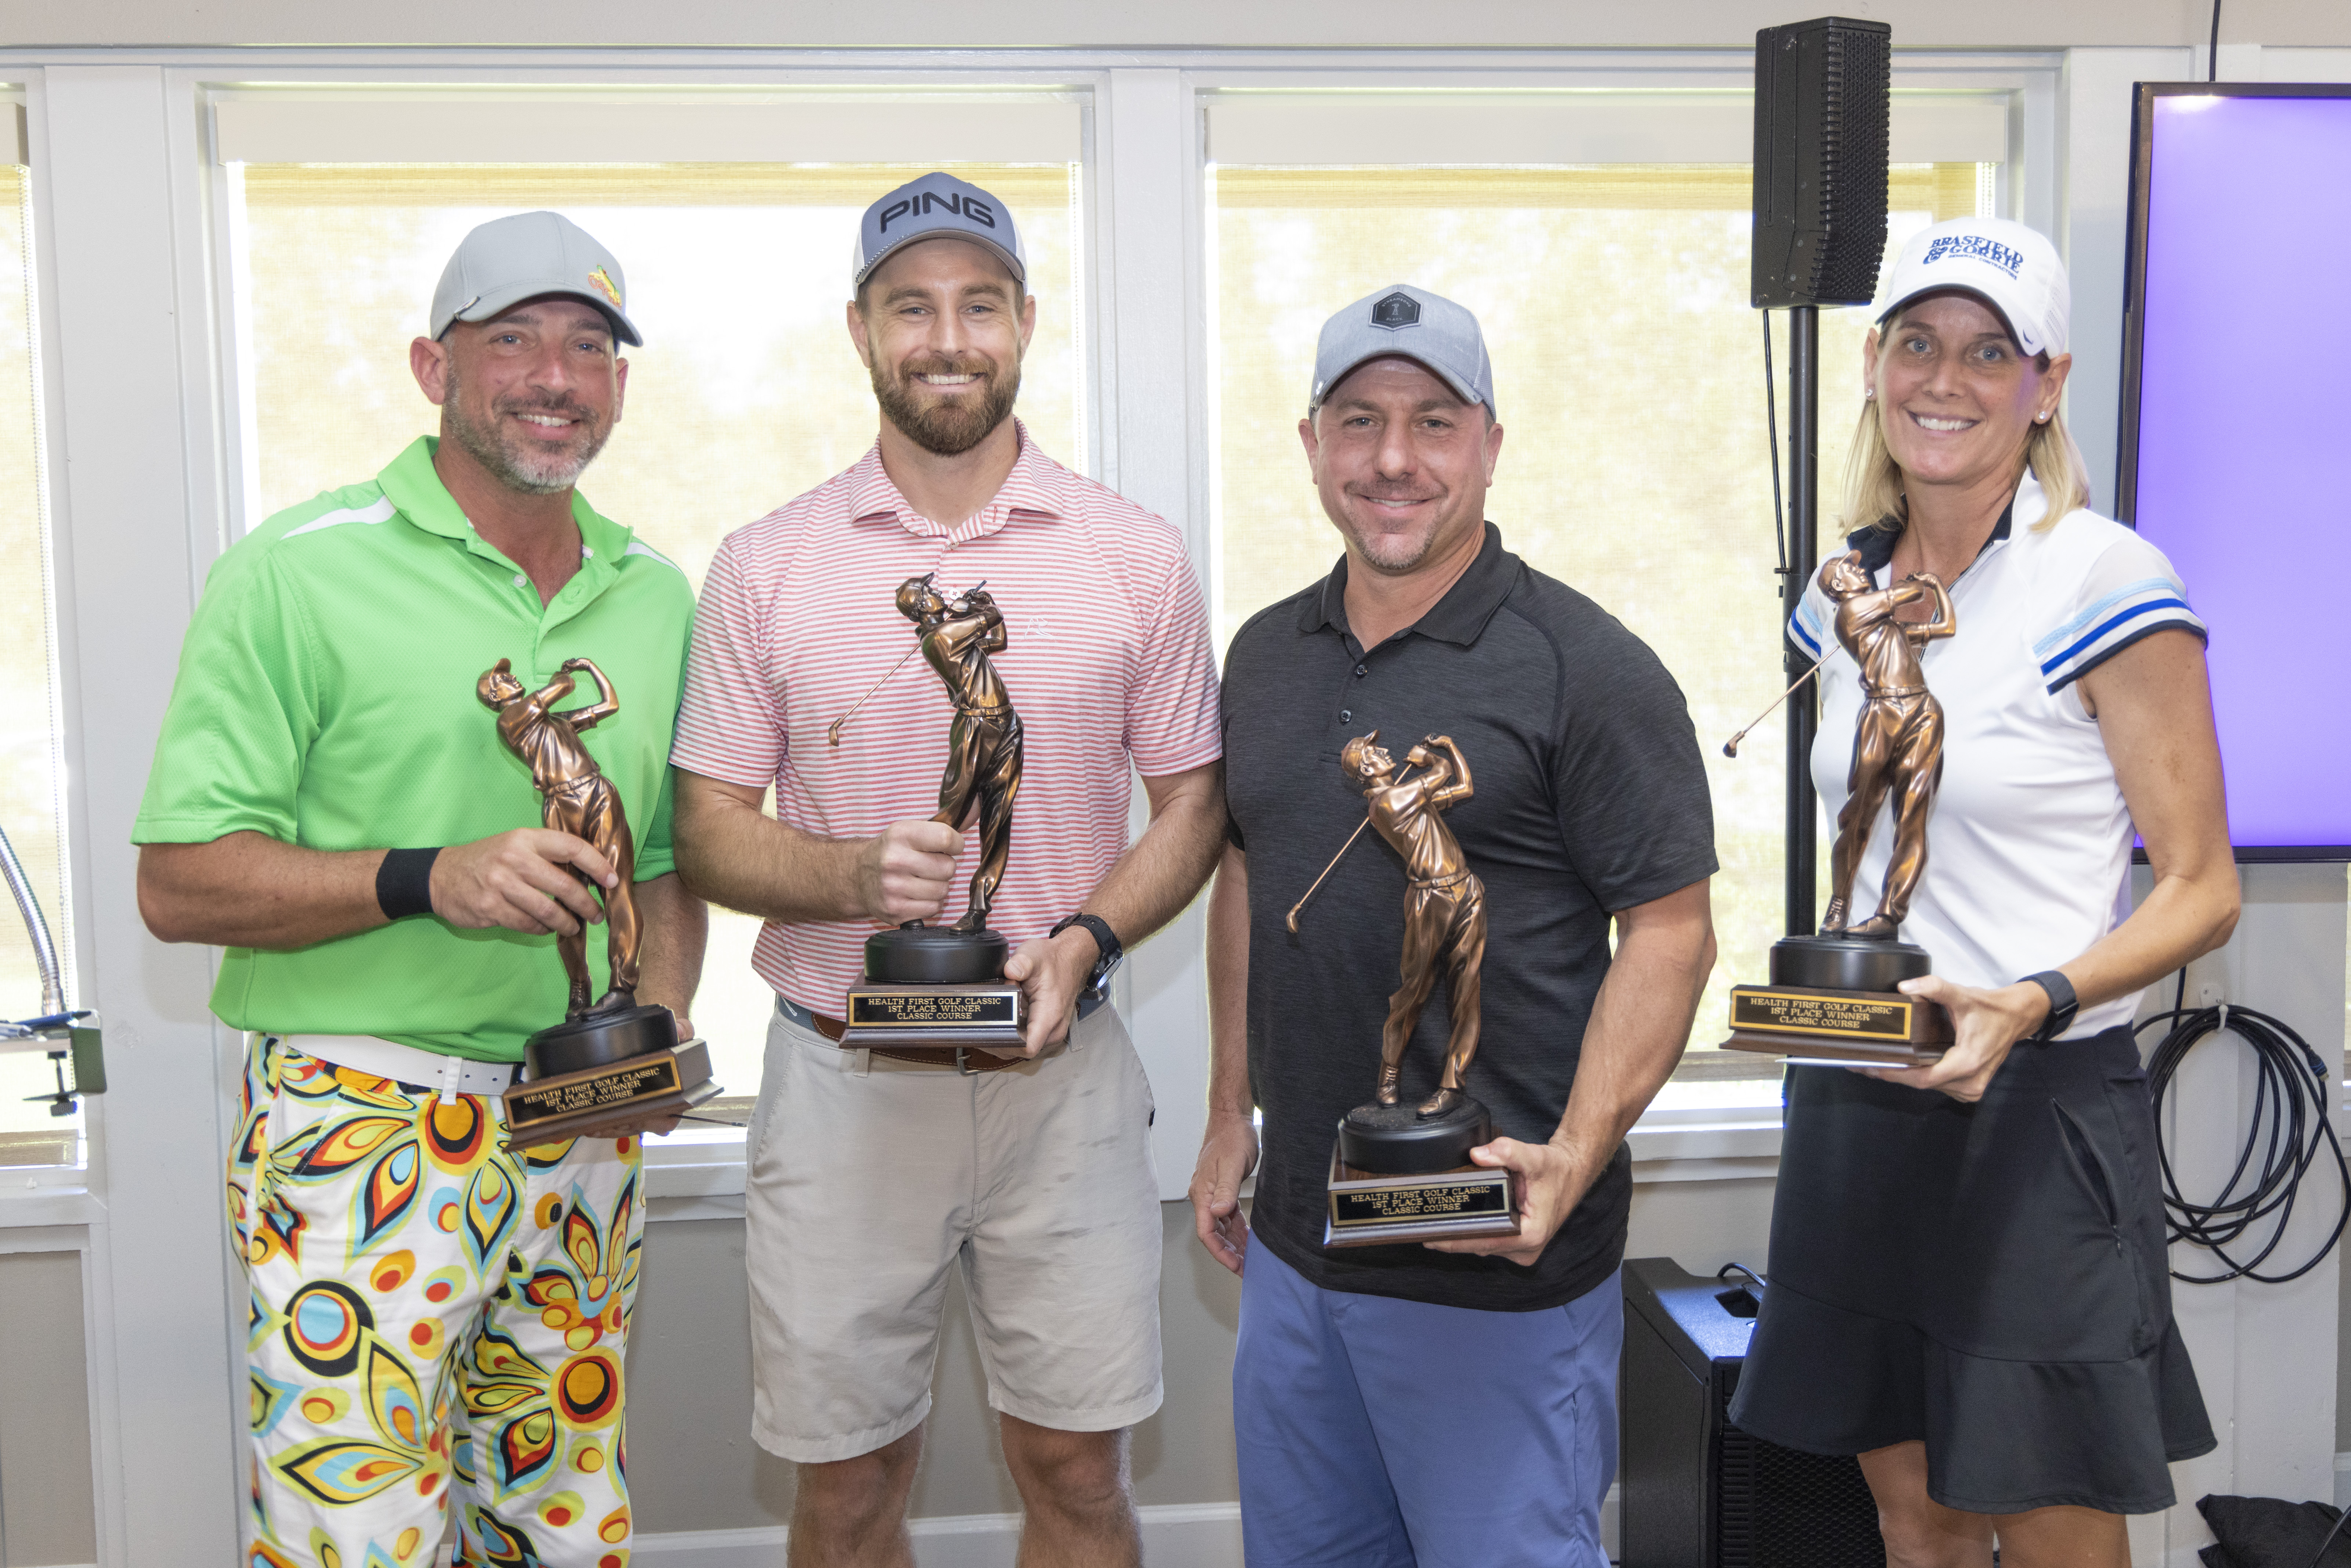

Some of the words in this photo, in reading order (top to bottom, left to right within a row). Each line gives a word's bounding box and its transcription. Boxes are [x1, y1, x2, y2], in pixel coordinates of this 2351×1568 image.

[881, 192, 995, 234] PING
[1923, 246, 1948, 264] &
[1949, 244, 2020, 274] GORRIE
[1929, 235, 2023, 263] BRASFIELD
[1979, 258, 2017, 280] CONTRACTORS
[588, 275, 622, 310] OAK
[1382, 298, 1411, 307] STREAMSONG
[1751, 998, 1788, 1007] HEALTH
[1793, 1001, 1820, 1009] FIRST
[1824, 1003, 1848, 1012] GOLF
[1853, 1005, 1892, 1014] CLASSIC
[1790, 1009, 1822, 1017] PLACE
[1827, 1011, 1869, 1021] WINNER
[1779, 1016, 1818, 1025] CLASSIC
[1821, 1019, 1859, 1028] COURSE
[524, 1089, 561, 1104] HEALTH
[565, 1083, 592, 1096] FIRST
[595, 1076, 619, 1089] GOLF
[622, 1068, 659, 1082] CLASSIC
[565, 1090, 595, 1103] PLACE
[600, 1080, 641, 1095] WINNER
[557, 1099, 594, 1112] CLASSIC
[597, 1089, 634, 1103] COURSE
[1351, 1194, 1389, 1202] HEALTH
[1393, 1191, 1420, 1199] FIRST
[1452, 1186, 1490, 1195] CLASSIC
[1392, 1198, 1423, 1207] PLACE
[1427, 1195, 1469, 1204] WINNER
[1382, 1206, 1420, 1215] CLASSIC
[1423, 1203, 1461, 1212] COURSE
